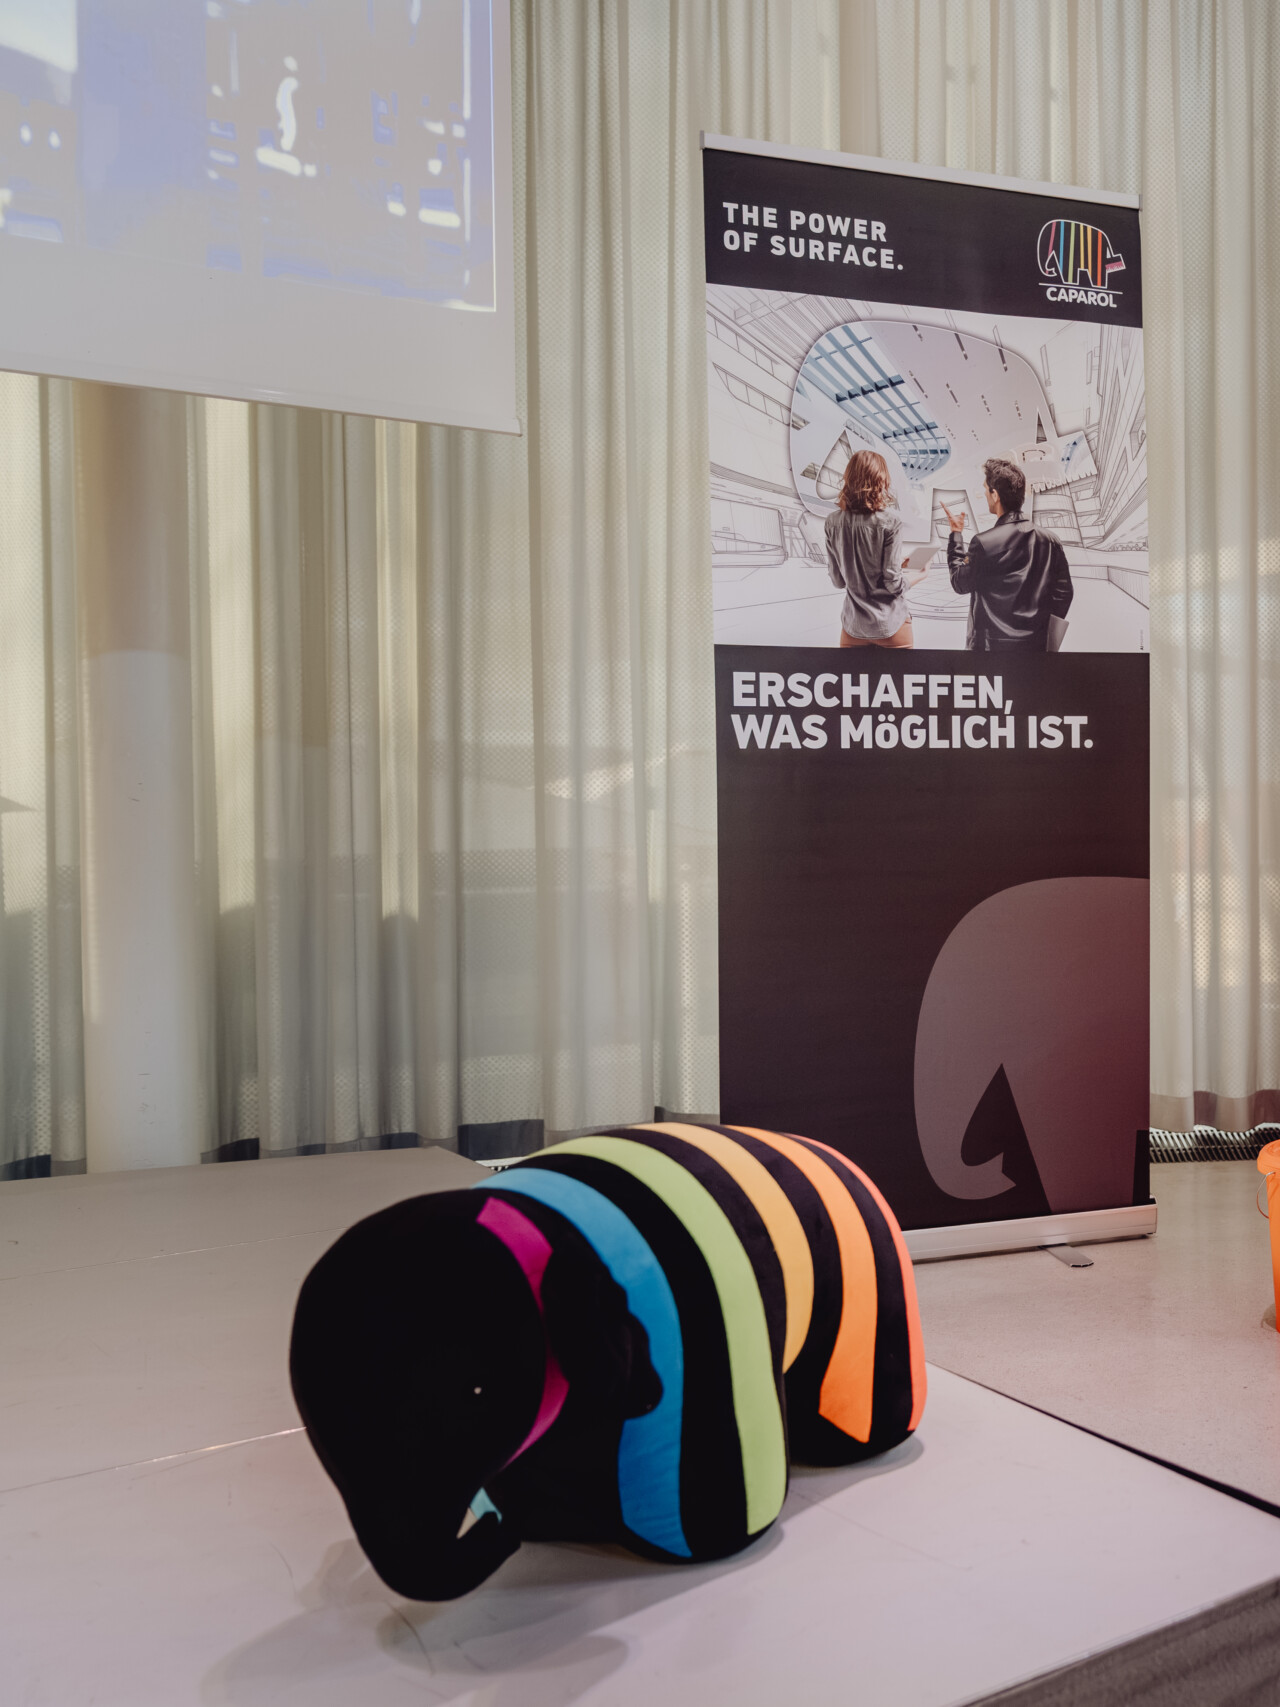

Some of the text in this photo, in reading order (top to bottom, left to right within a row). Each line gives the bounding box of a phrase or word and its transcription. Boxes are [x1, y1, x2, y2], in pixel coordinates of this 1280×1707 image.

[723, 202, 887, 242] THE POWER
[723, 230, 903, 271] OF SURFACE.
[1047, 287, 1117, 307] CAPAROL
[733, 672, 1013, 714] ERSCHAFFEN,
[732, 714, 1093, 749] WAS MöGLICH IST.
